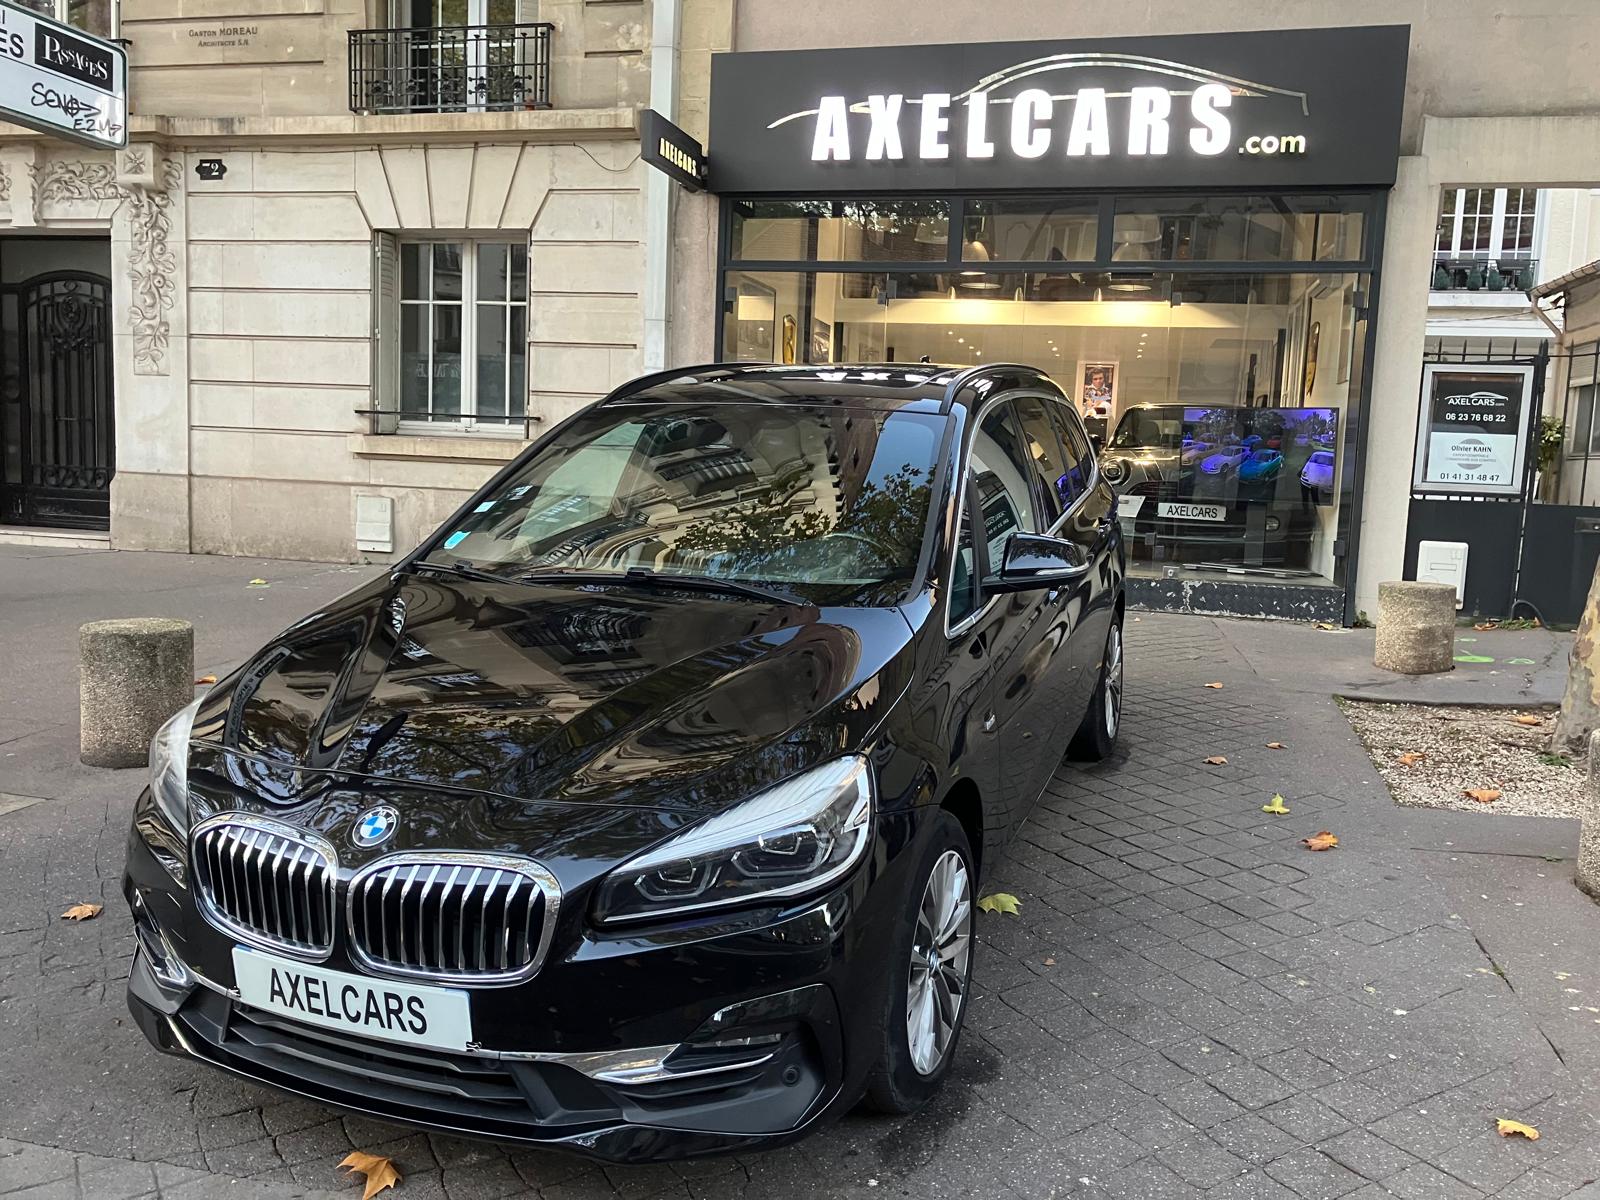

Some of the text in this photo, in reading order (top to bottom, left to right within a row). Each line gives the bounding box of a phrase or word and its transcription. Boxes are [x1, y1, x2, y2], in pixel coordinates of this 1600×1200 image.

[219, 26, 258, 37] MOREAU
[42, 34, 108, 80] PASSAGES
[811, 84, 1233, 161] AXELCARS
[1445, 412, 1506, 422] 06 23 76 68 22
[1440, 472, 1449, 480] 01
[1464, 473, 1474, 481] 31
[1489, 474, 1500, 482] 47
[1166, 505, 1218, 519] AXELCARS
[269, 967, 428, 1035] AXELCARS
